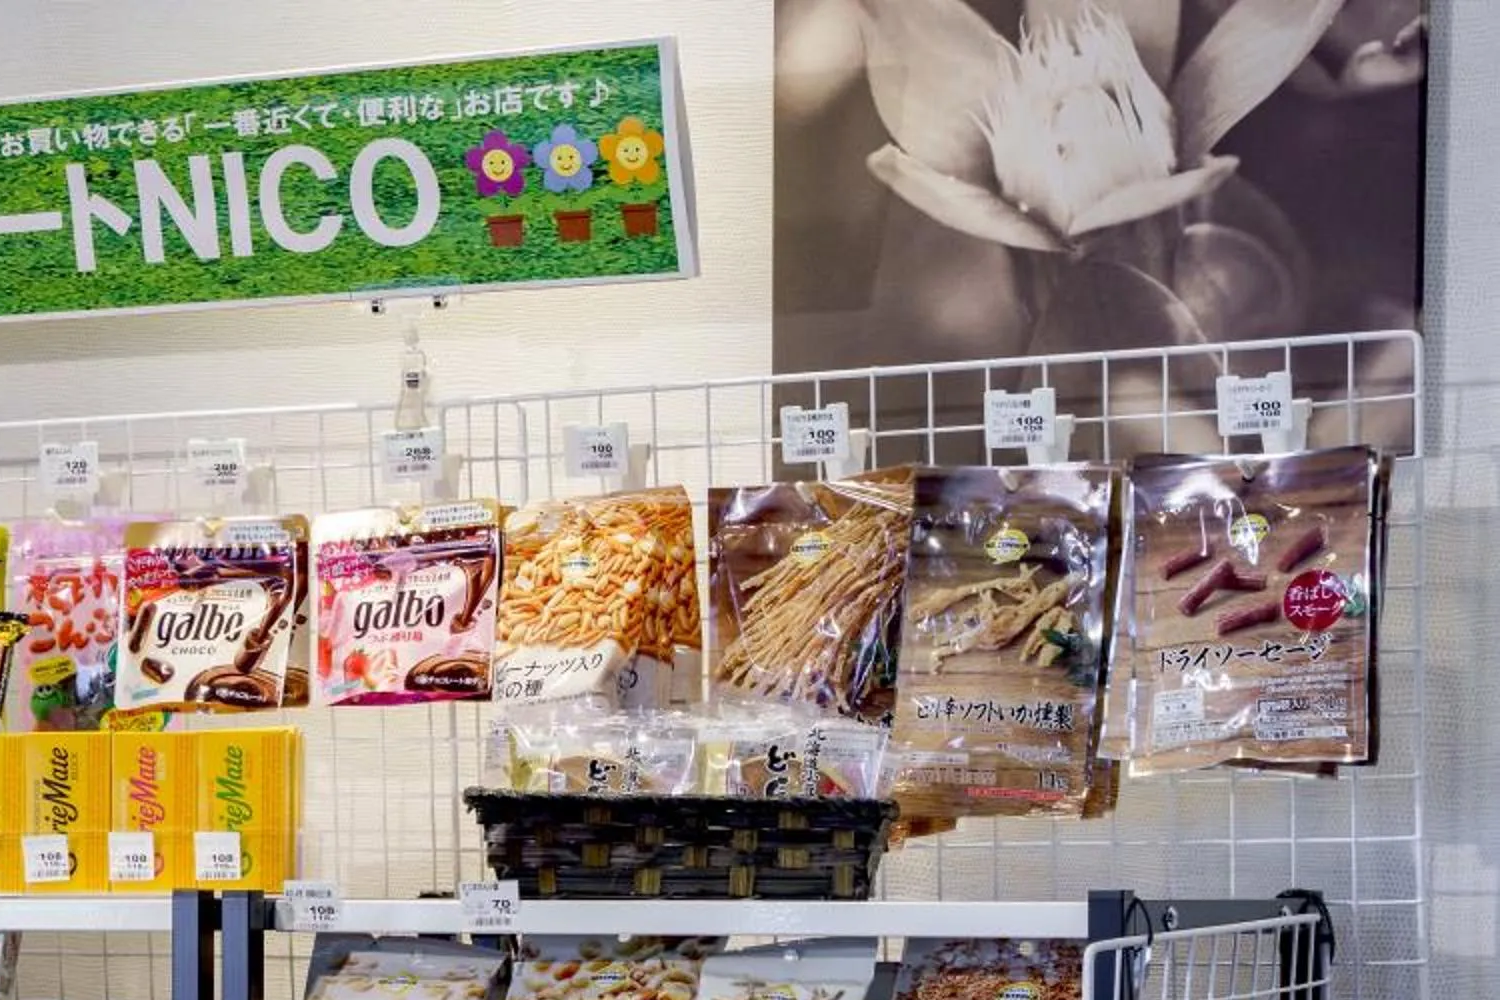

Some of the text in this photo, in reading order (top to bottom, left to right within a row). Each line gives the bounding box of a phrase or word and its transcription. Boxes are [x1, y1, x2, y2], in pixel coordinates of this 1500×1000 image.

[1015, 416, 1044, 426] 100
[1251, 400, 1281, 411] 100
[590, 444, 613, 453] 100
[809, 429, 836, 439] 100
[155, 603, 245, 649] galbo
[353, 589, 446, 640] galbo
[1159, 633, 1334, 673] ドライソーセージ
[498, 677, 542, 699] の種
[42, 746, 80, 834] rieMate
[129, 745, 166, 832] rieMate
[215, 744, 253, 832] rieMate
